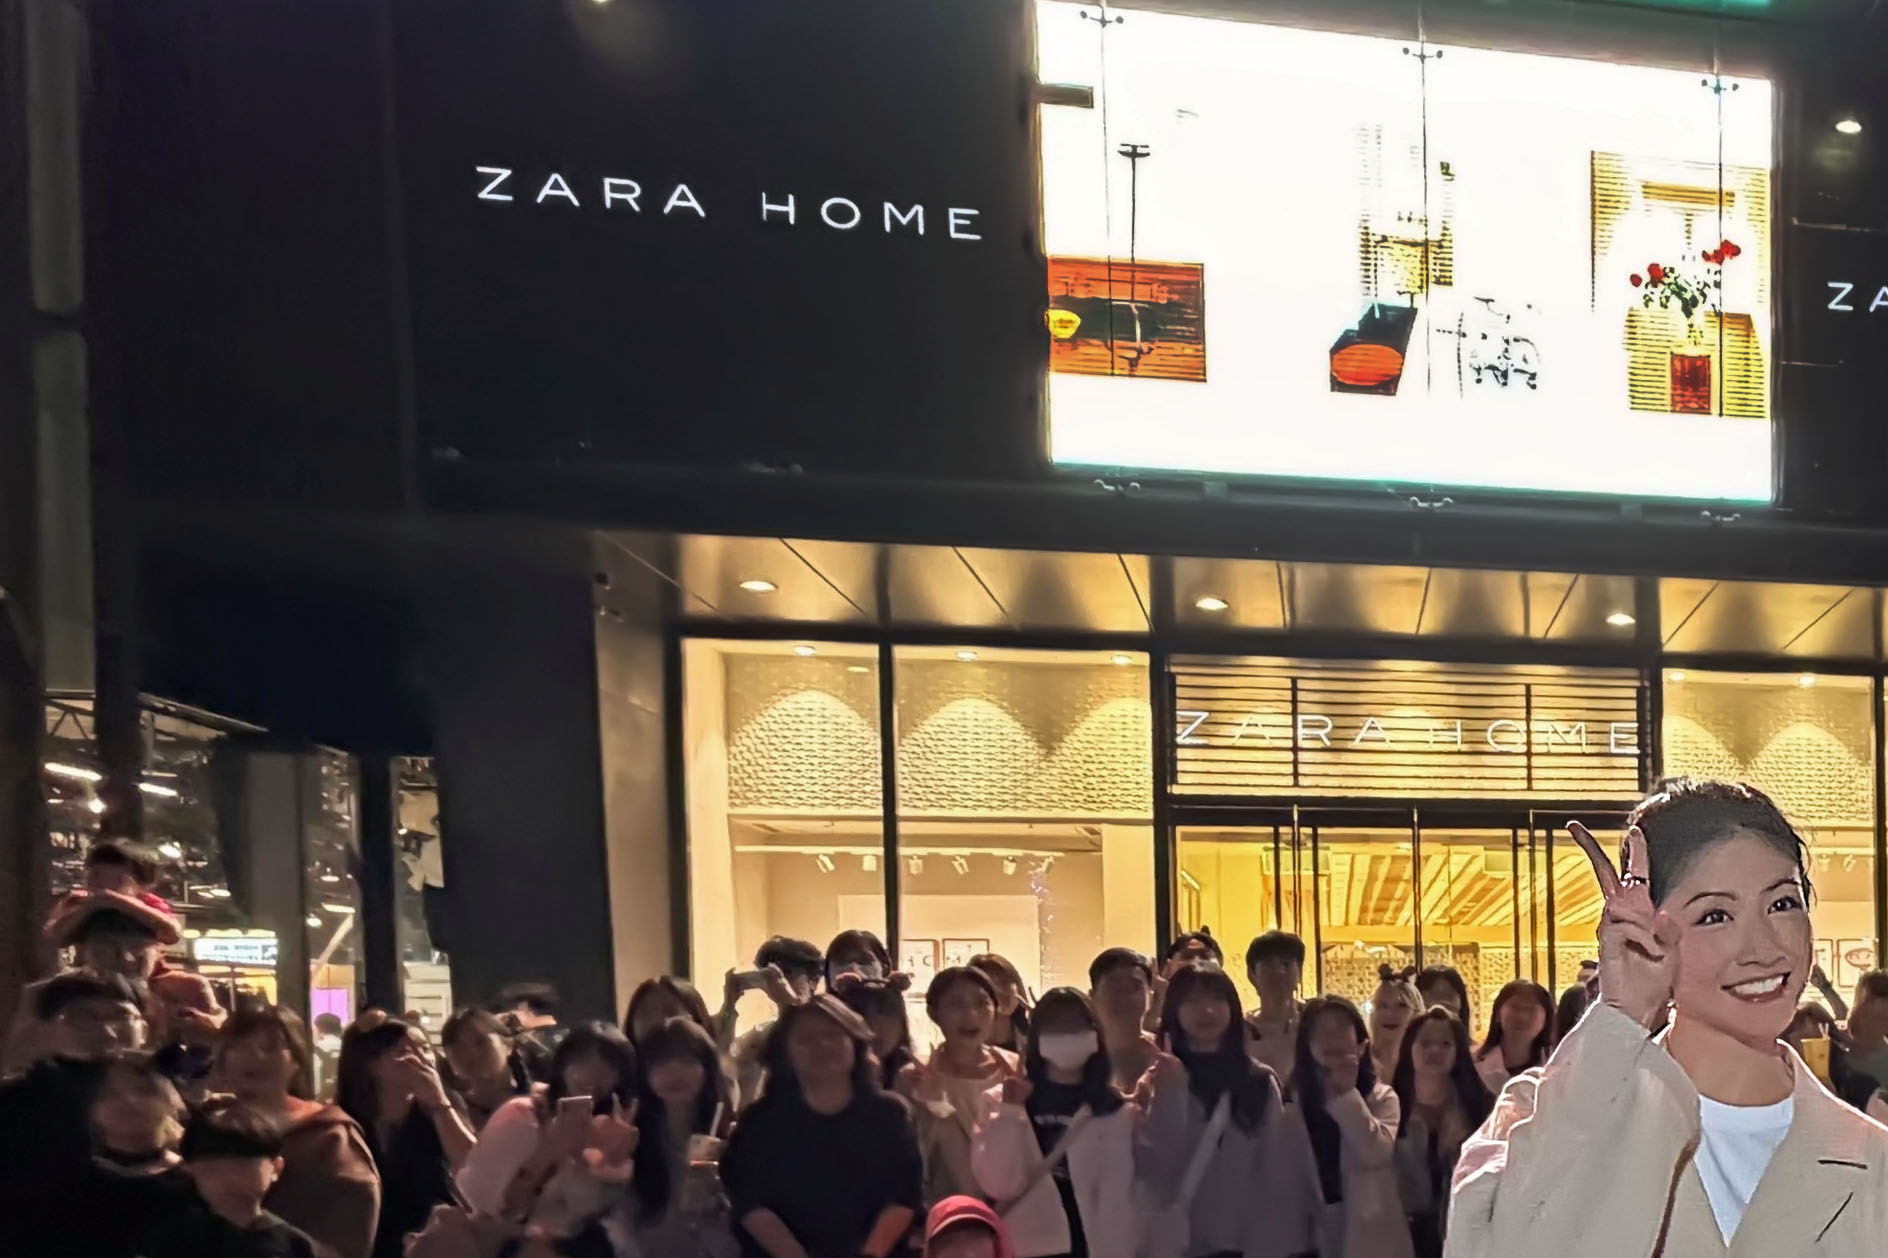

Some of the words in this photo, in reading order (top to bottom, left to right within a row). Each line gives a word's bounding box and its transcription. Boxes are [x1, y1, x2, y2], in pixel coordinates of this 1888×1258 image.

[474, 165, 706, 220] ZARA
[761, 191, 983, 242] HOME
[1175, 710, 1393, 747] ZARA
[1427, 717, 1642, 755] HOME
